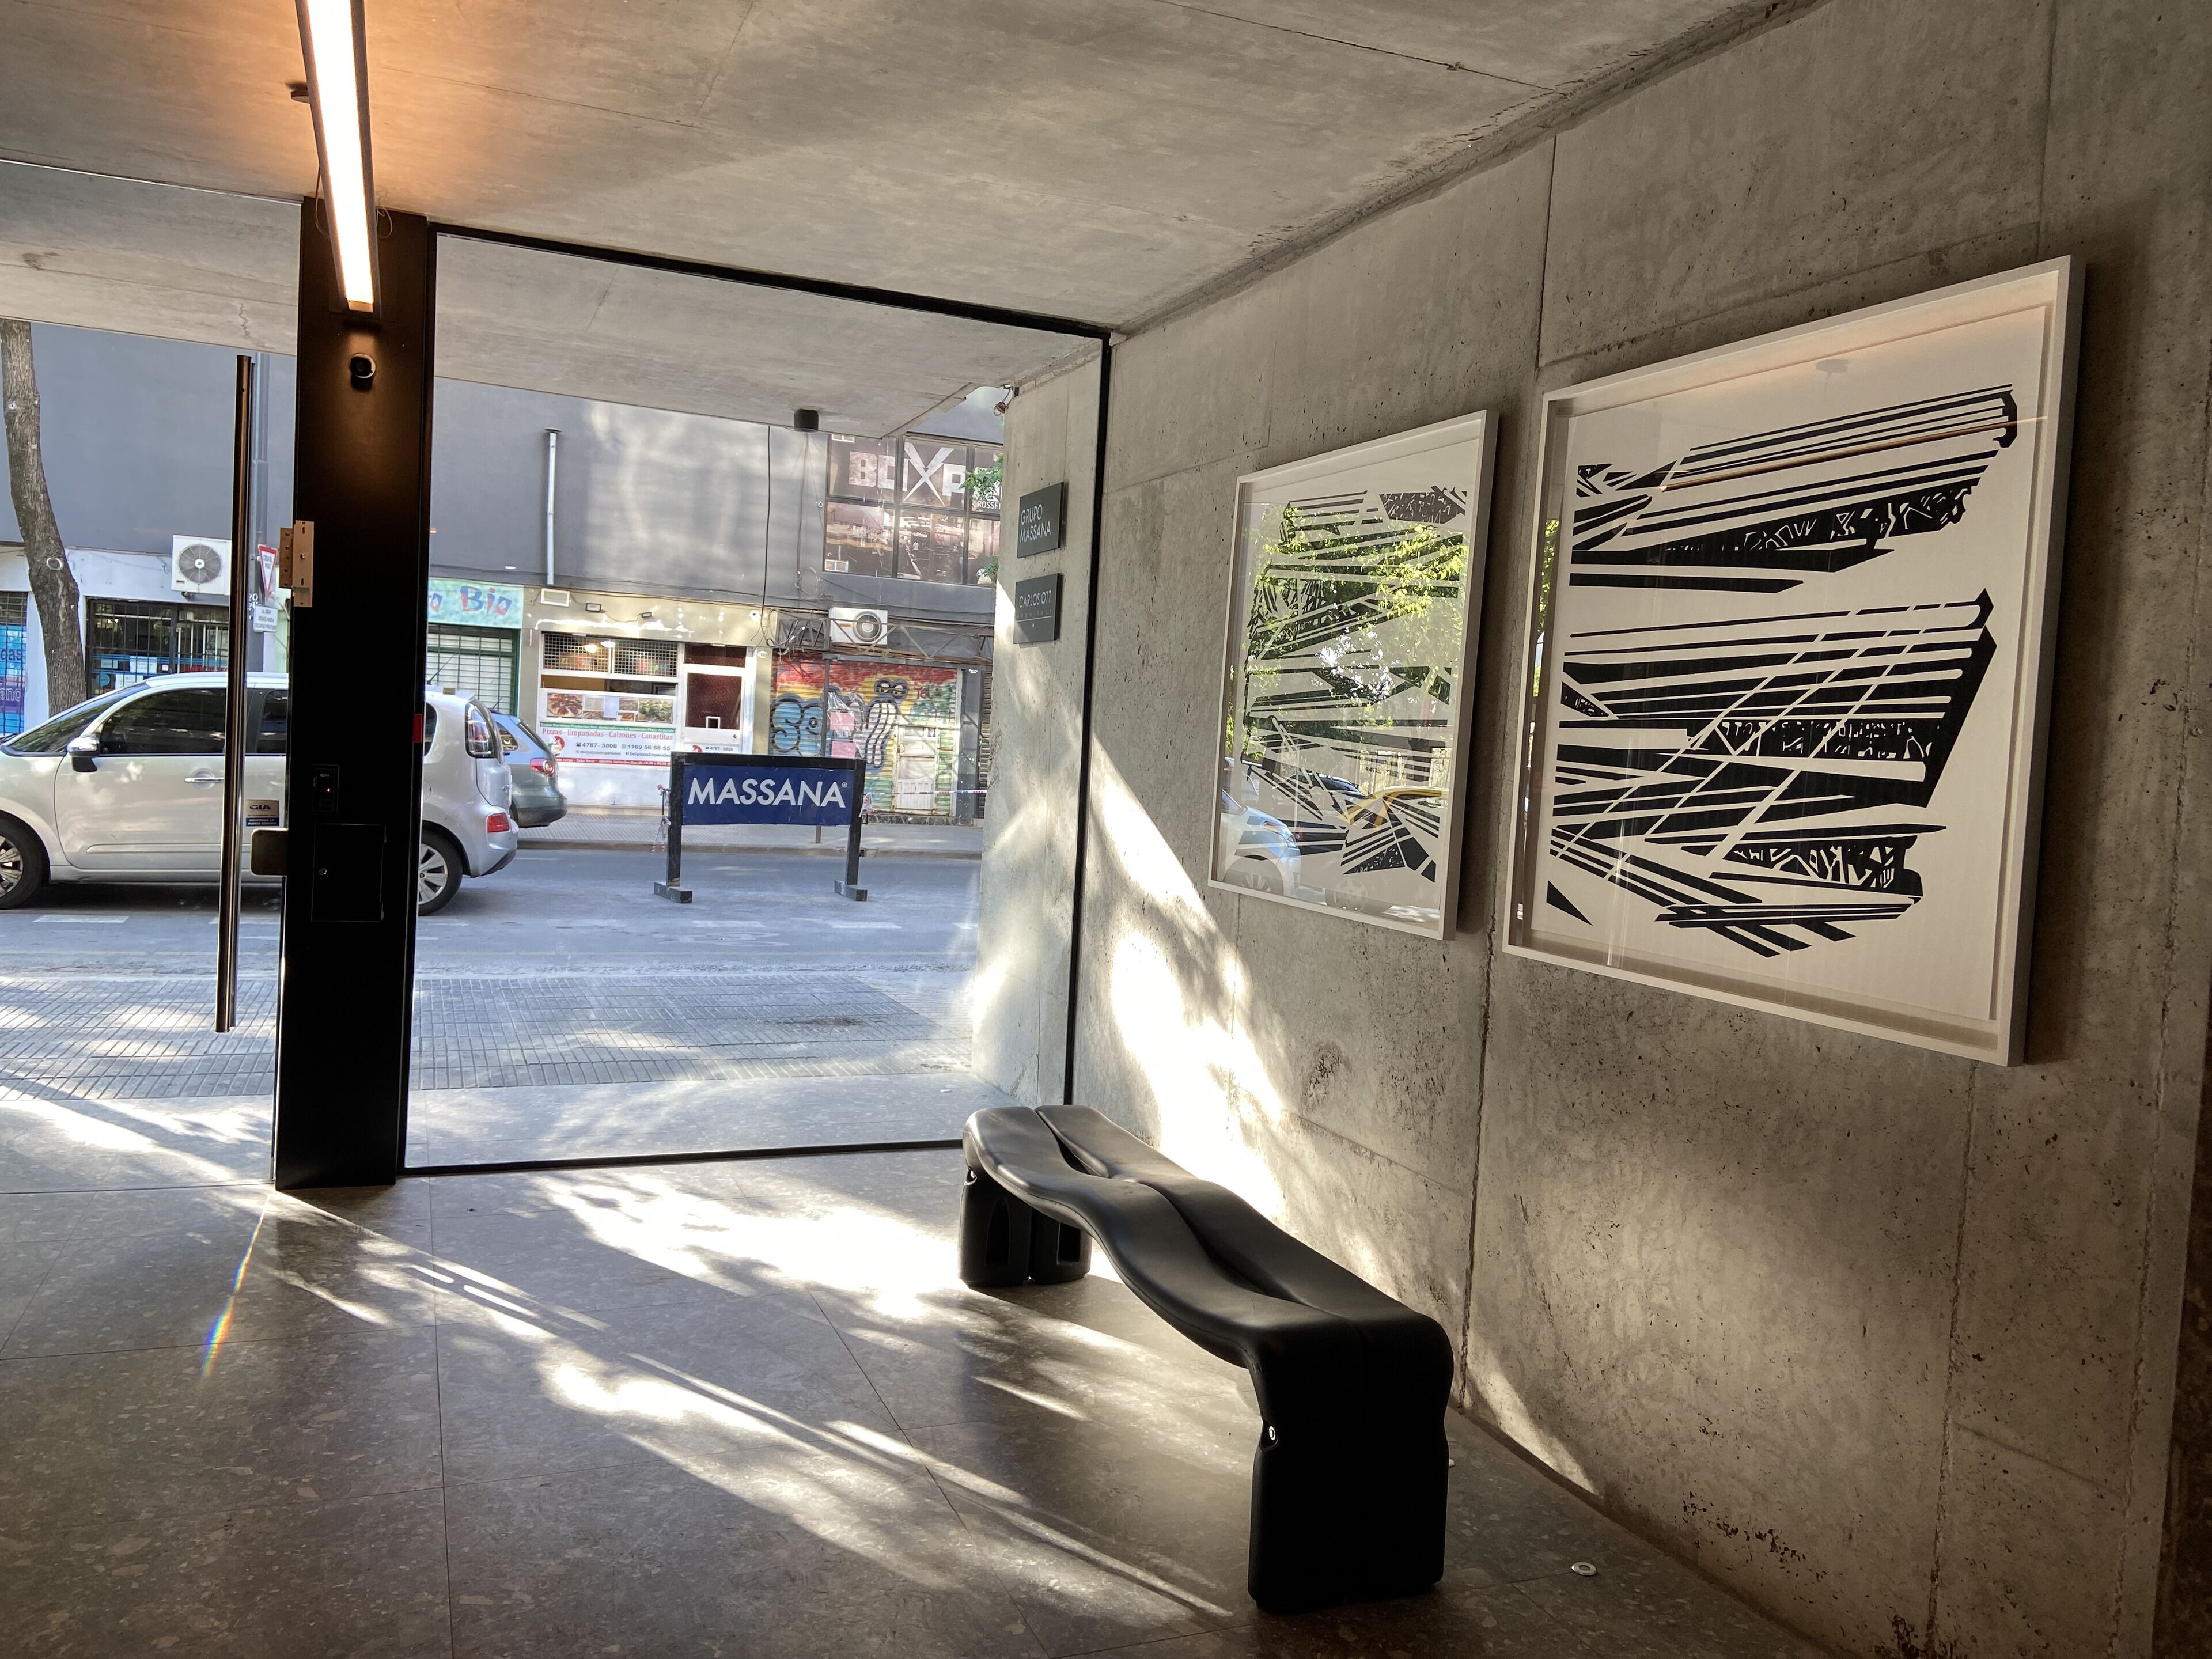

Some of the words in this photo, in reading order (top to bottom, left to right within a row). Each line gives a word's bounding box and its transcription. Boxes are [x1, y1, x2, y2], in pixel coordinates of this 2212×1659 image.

[1021, 504, 1043, 525] GRUPO
[1020, 521, 1051, 544] MASSANA
[460, 586, 512, 616] Bio
[1019, 592, 1040, 608] CARLOS
[1041, 590, 1052, 605] OTT
[567, 729, 604, 737] Empanadas
[609, 730, 637, 738] Calzones
[641, 732, 673, 740] Canastitas
[687, 777, 846, 808] MASSANA
